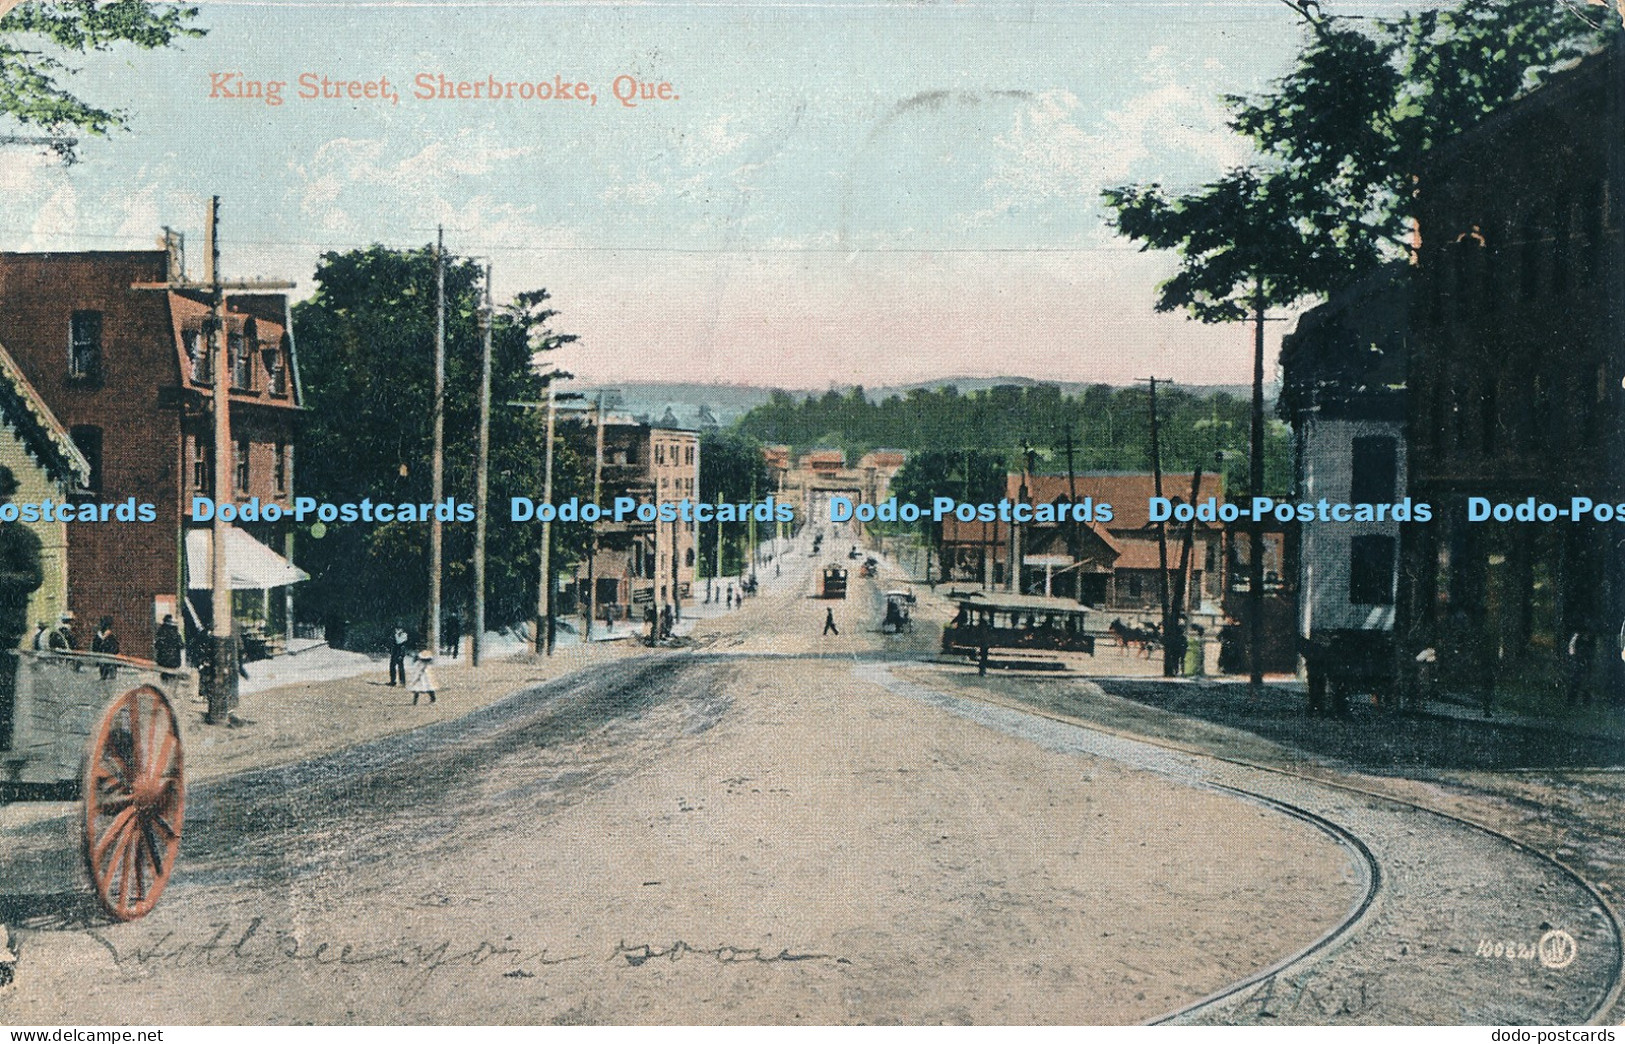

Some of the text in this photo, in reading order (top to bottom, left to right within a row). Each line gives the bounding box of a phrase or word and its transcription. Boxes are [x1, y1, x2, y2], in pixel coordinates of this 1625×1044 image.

[209, 72, 681, 108] King Street, Sherbrooke, Que.
